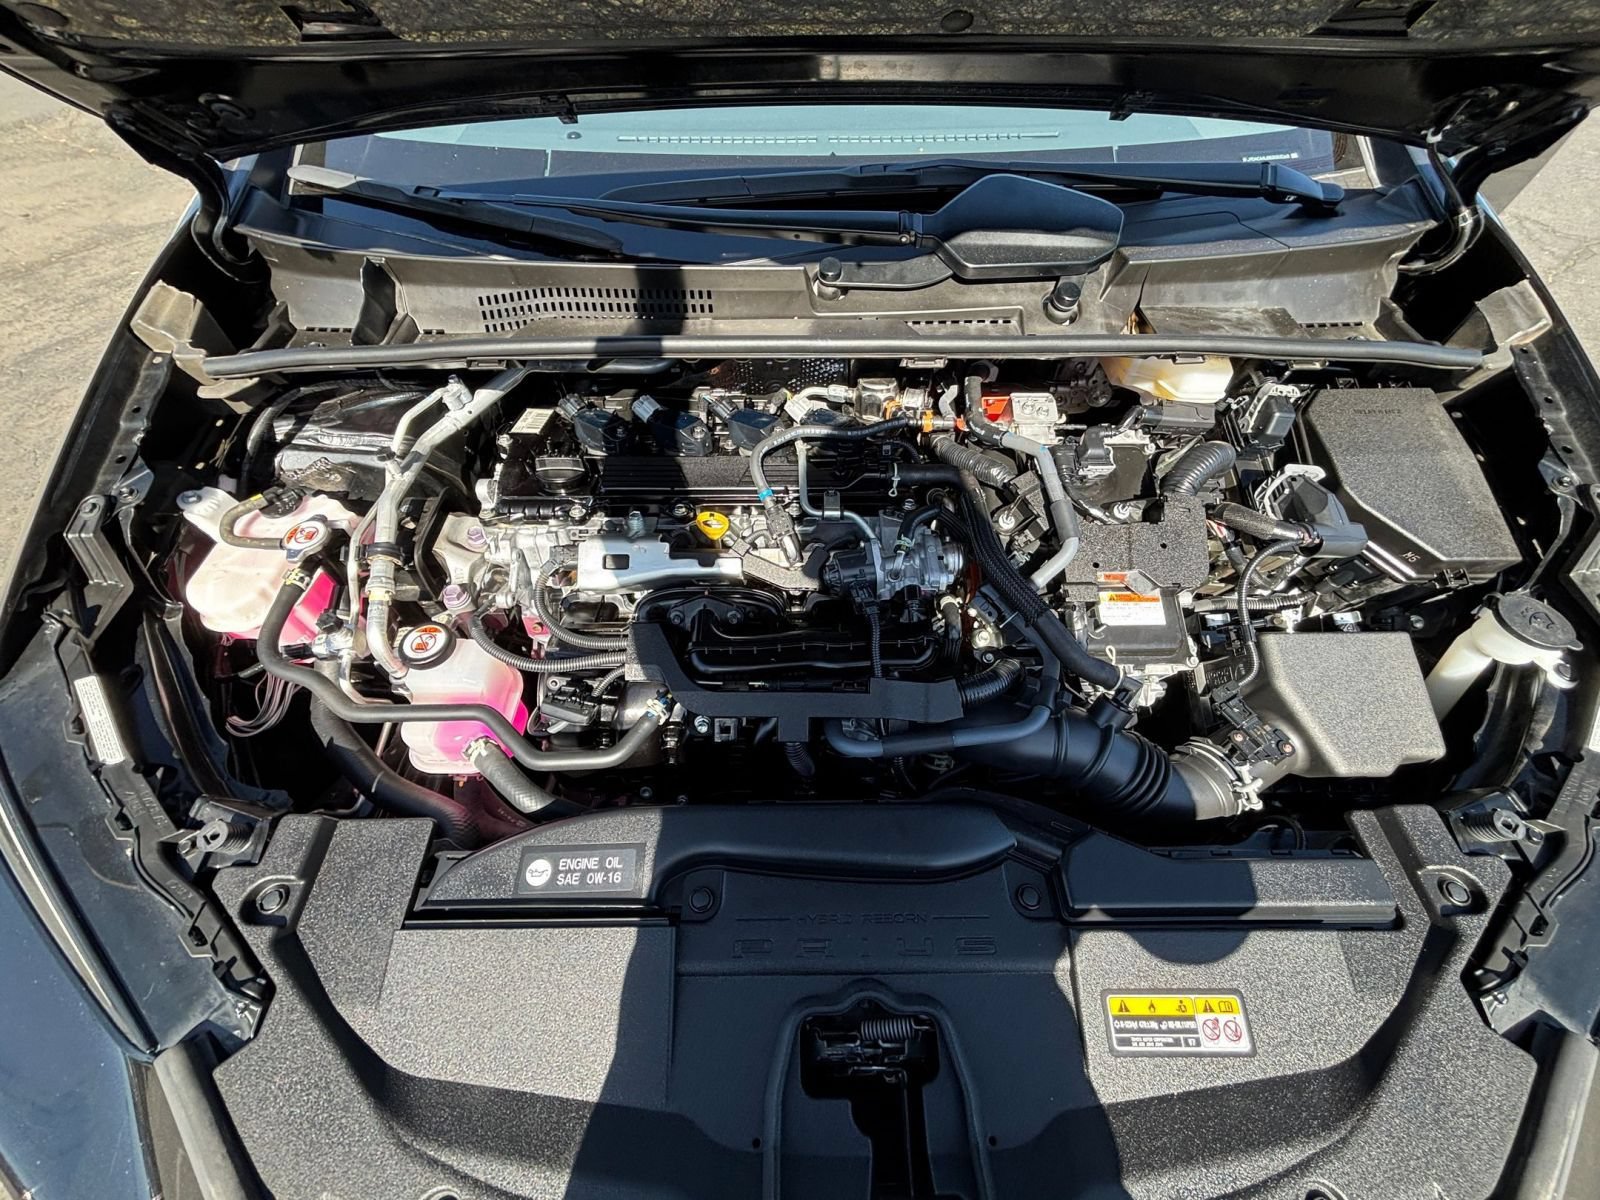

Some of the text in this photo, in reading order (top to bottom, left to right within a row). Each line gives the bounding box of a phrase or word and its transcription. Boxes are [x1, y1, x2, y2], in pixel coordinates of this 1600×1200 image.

[558, 856, 623, 870] ENGINE OIL
[556, 871, 622, 886] SAE 0W-16
[861, 911, 928, 925] REBORN
[733, 937, 997, 958] PRIUS
